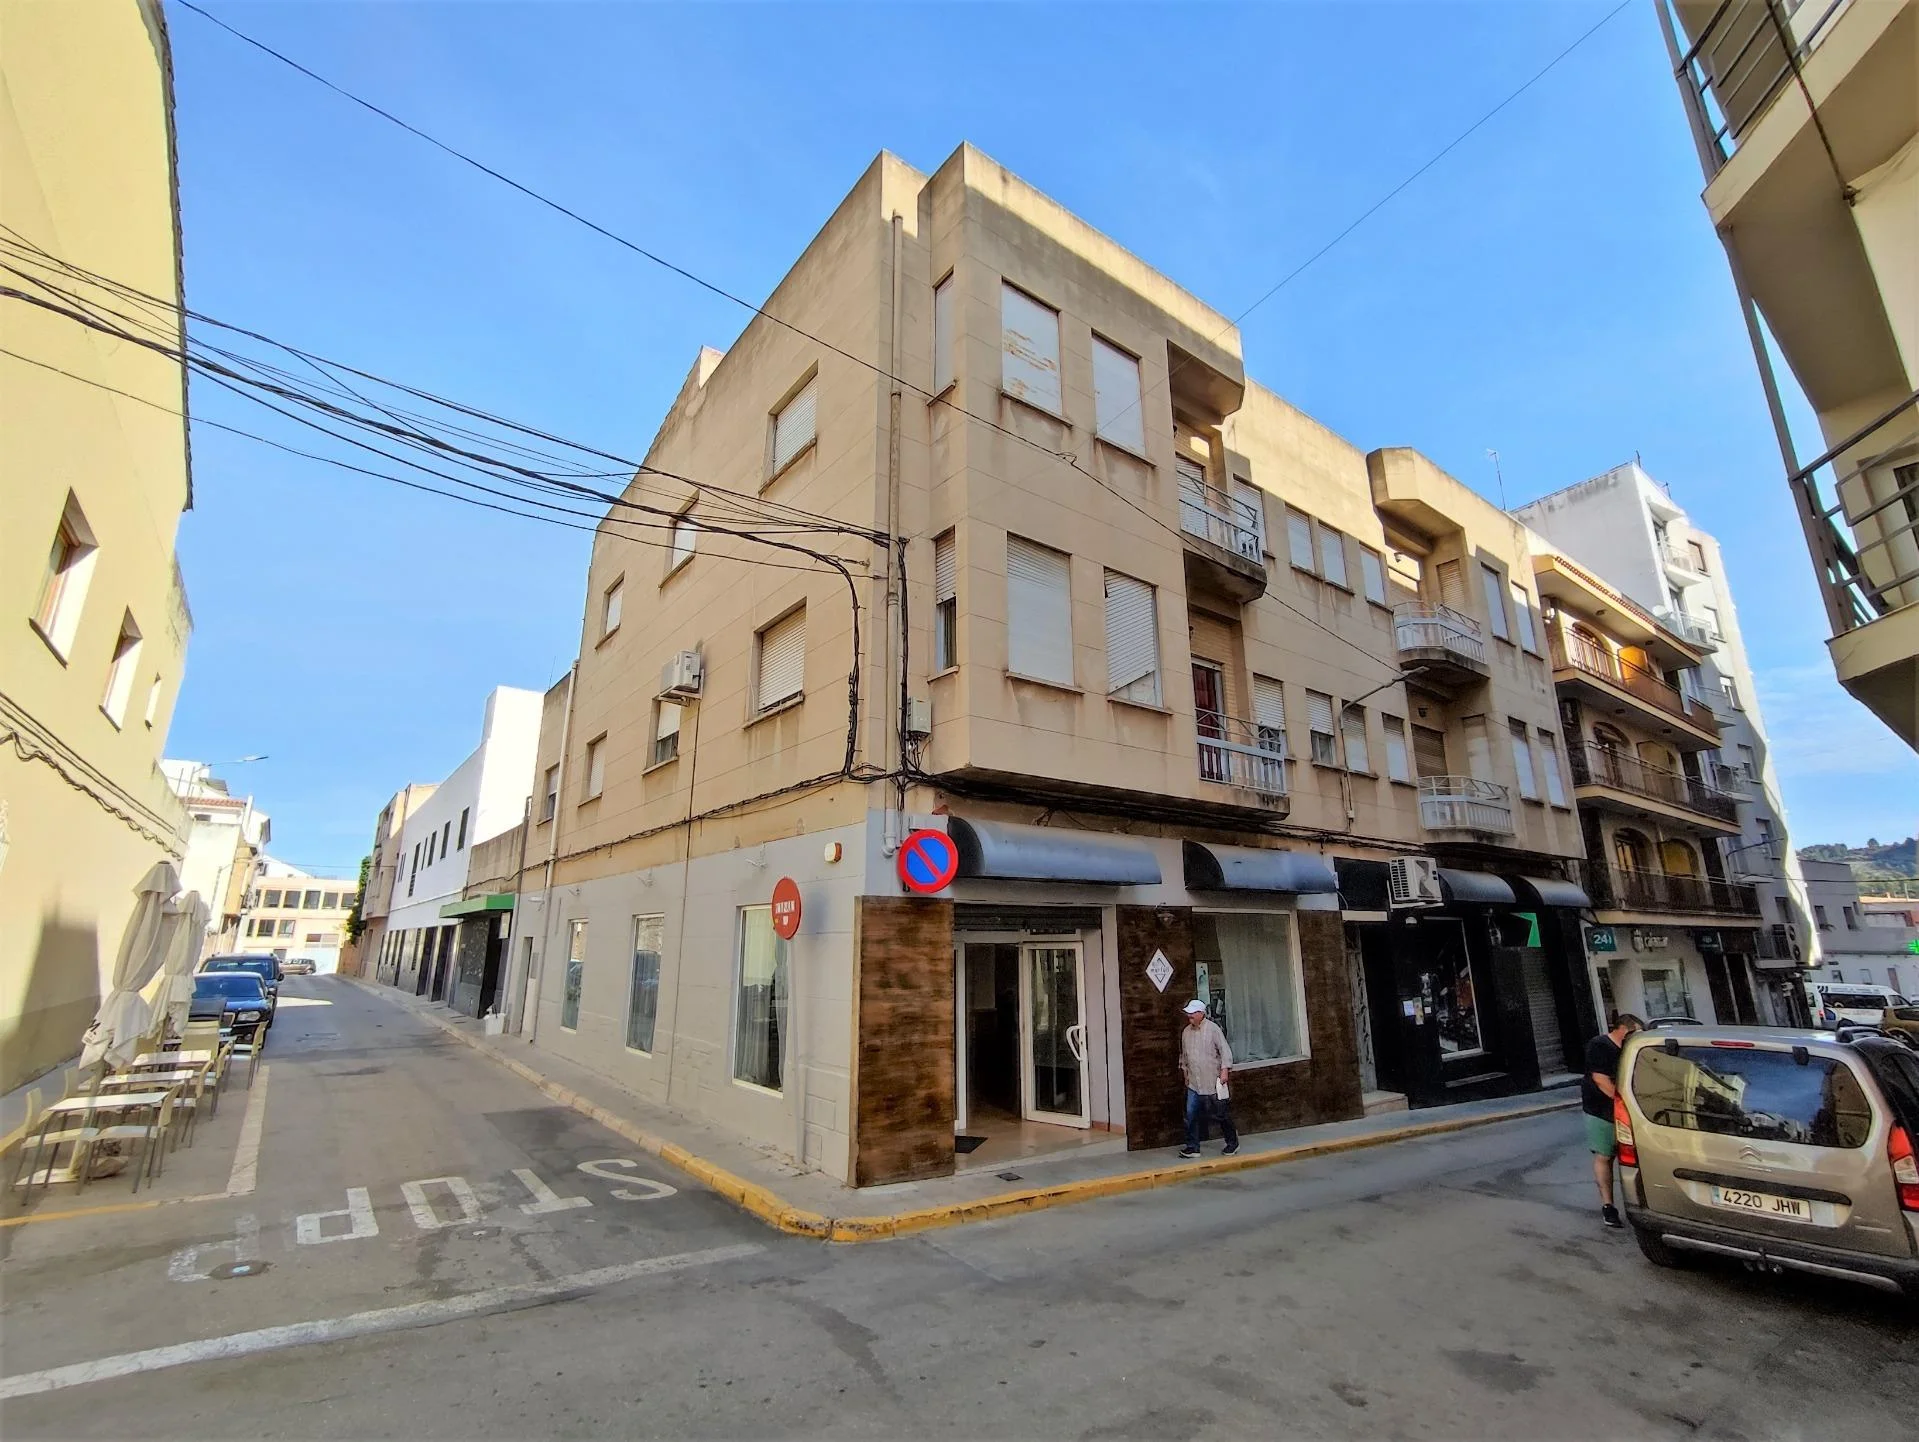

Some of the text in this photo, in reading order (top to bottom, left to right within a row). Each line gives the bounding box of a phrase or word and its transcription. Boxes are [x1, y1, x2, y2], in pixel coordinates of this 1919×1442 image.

[297, 1158, 678, 1245] STOP
[1723, 1190, 1801, 1215] 4220 JHW
